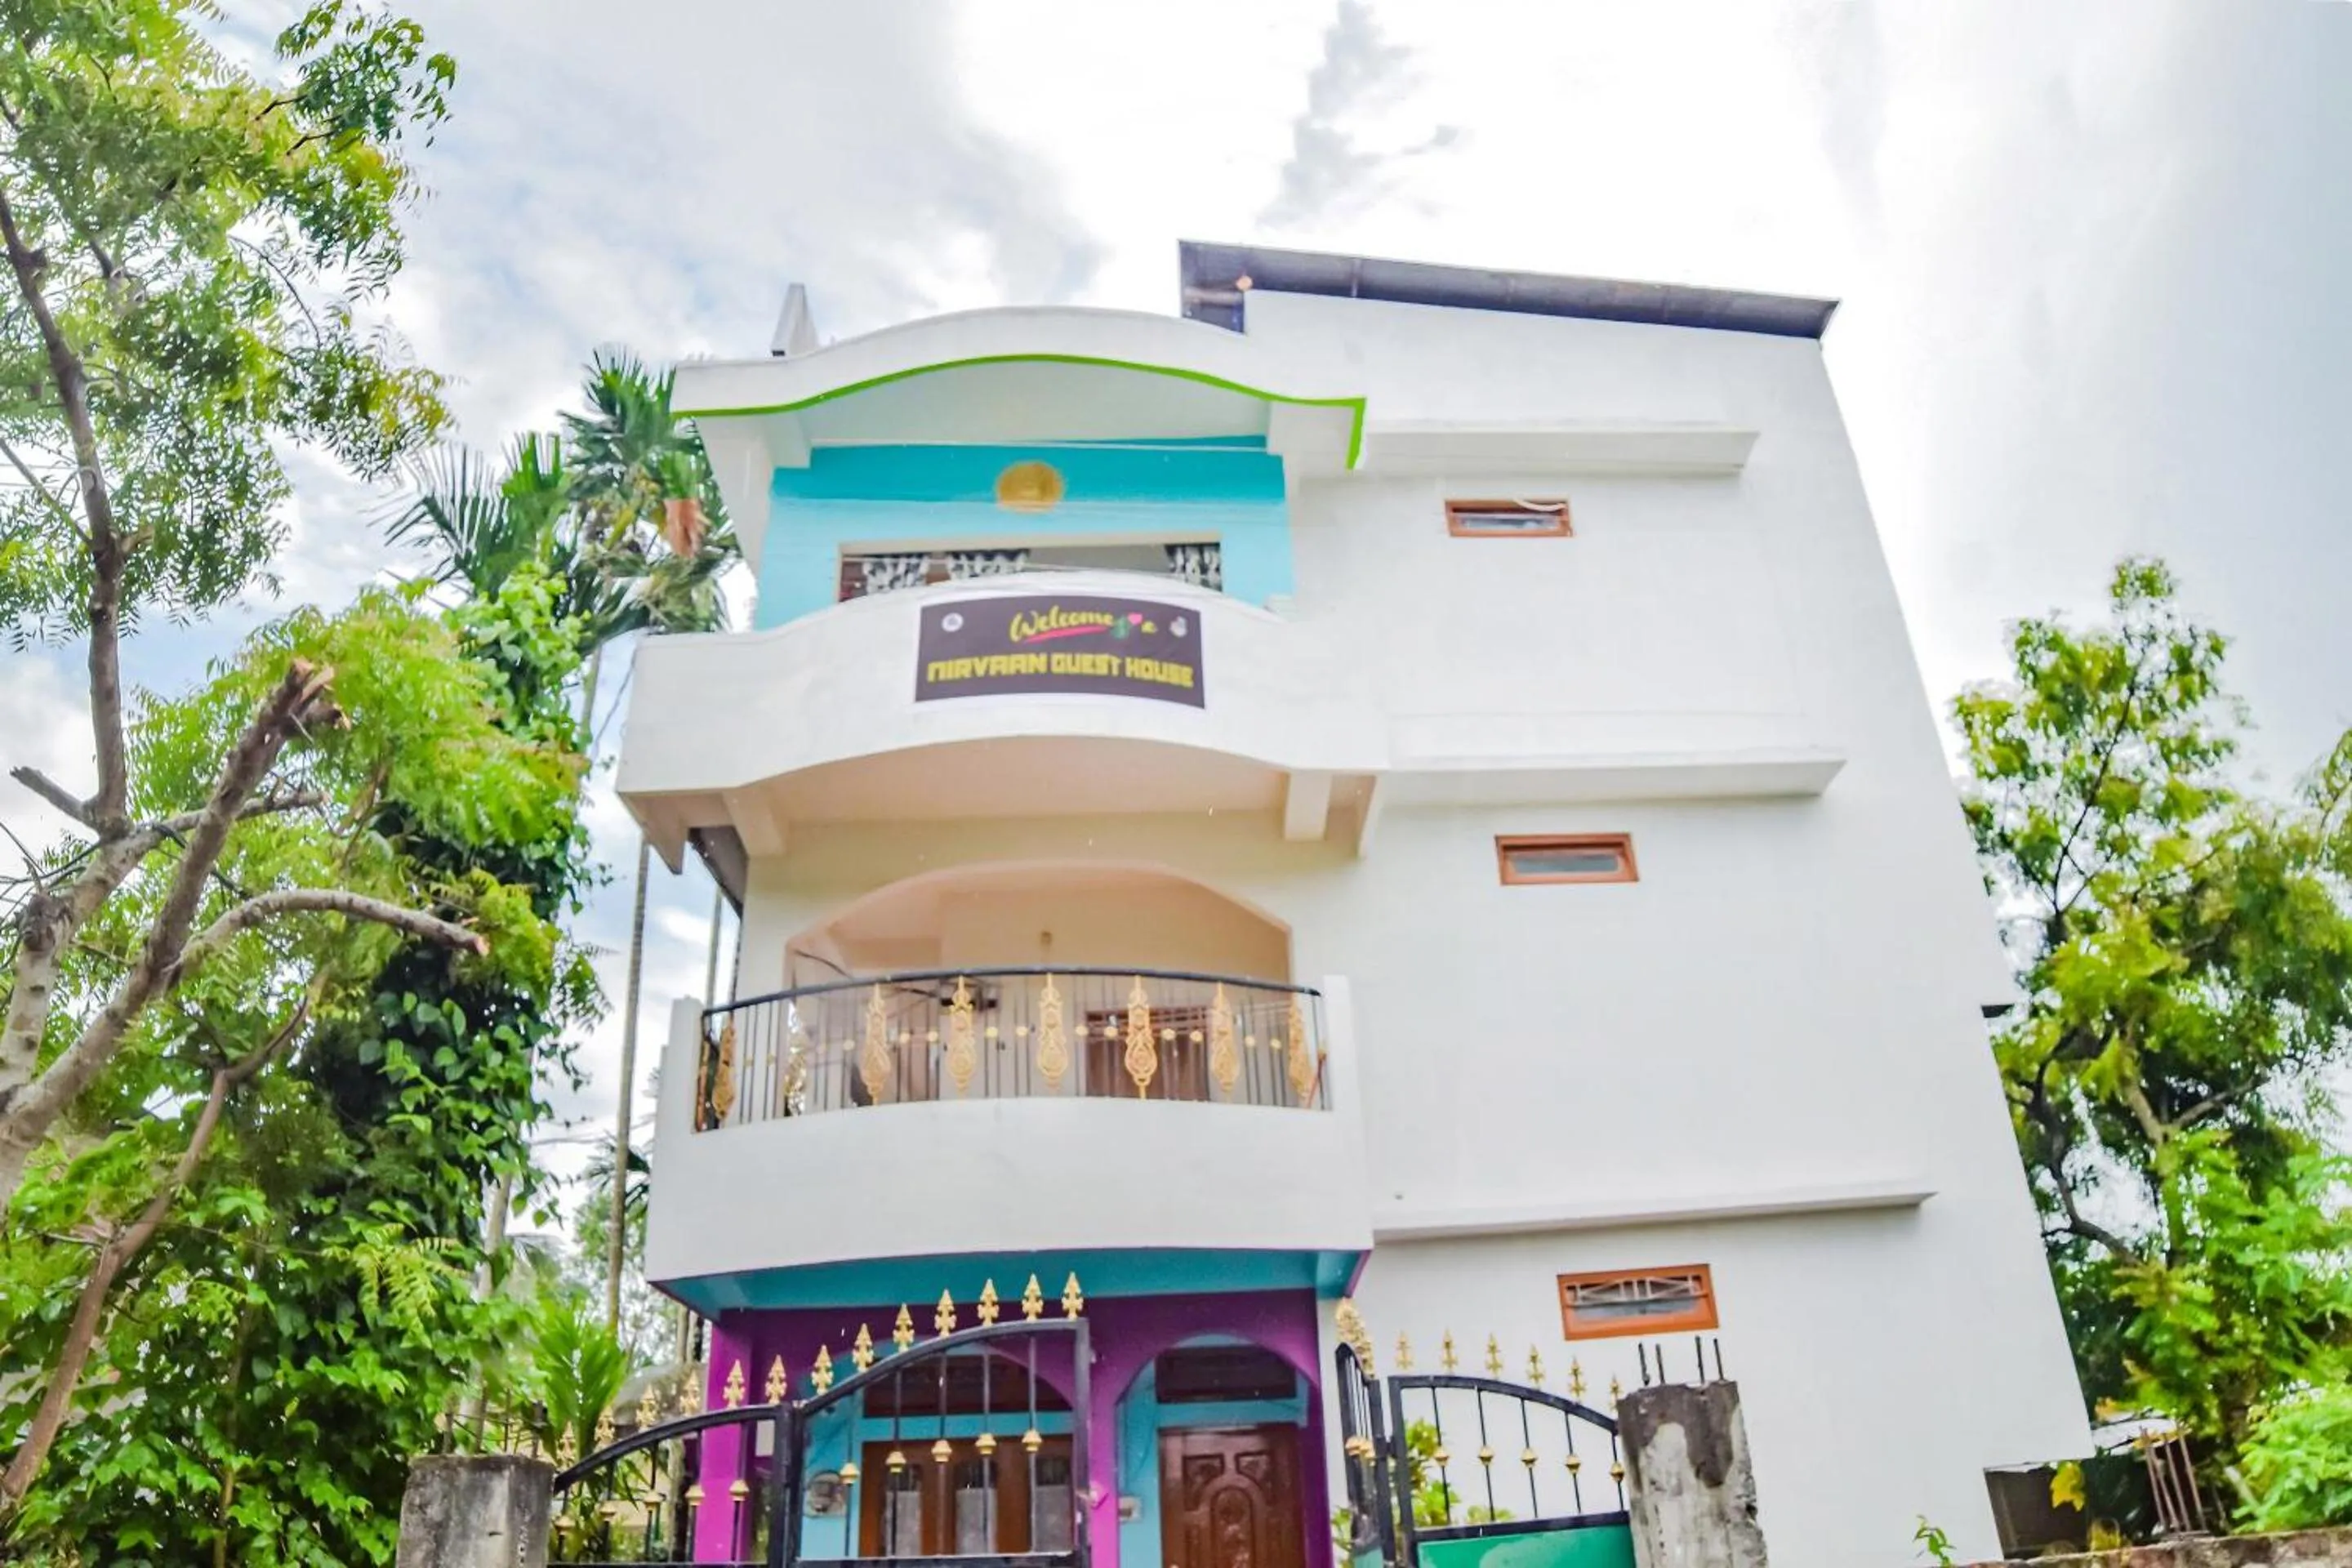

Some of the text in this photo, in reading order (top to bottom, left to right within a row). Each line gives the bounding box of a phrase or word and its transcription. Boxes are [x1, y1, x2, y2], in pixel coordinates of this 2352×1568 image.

[1009, 604, 1114, 643] Welcome
[927, 653, 1194, 688] NIRVAAN GUEST HOUSE
